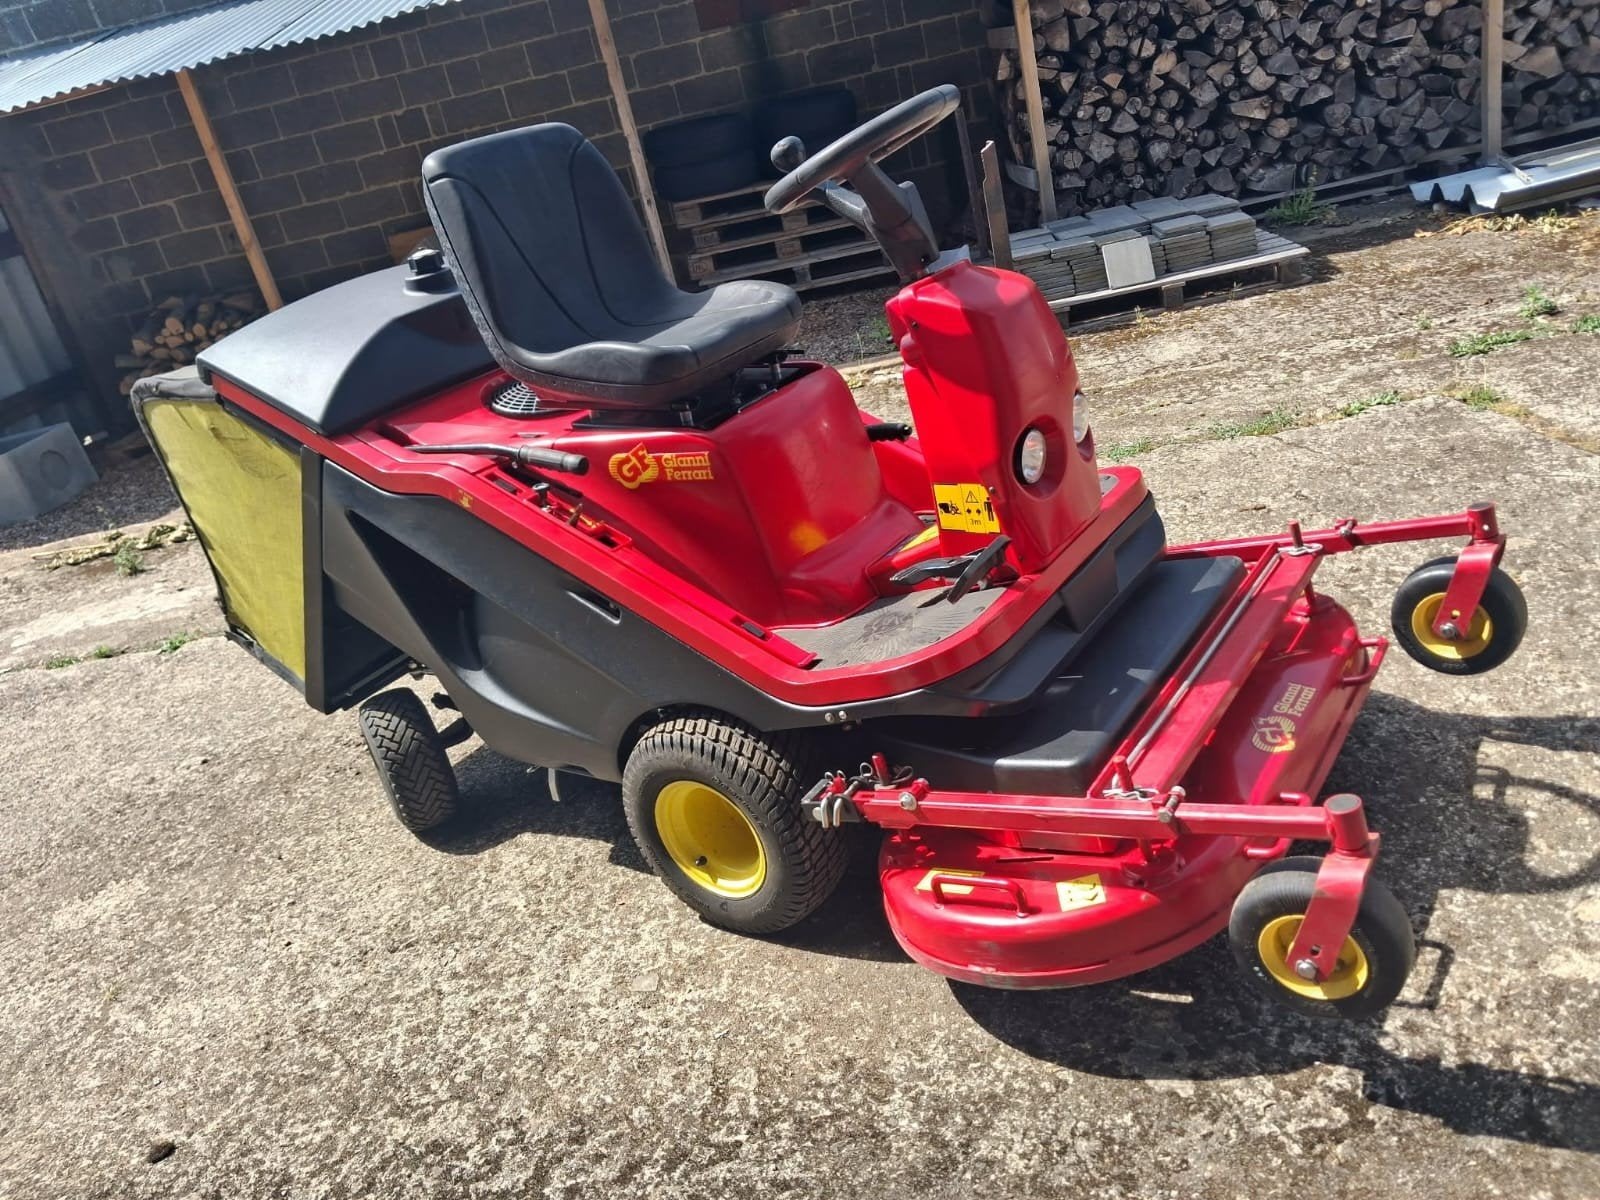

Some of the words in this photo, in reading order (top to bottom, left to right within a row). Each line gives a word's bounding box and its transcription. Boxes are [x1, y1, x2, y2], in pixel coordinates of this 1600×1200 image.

[662, 451, 711, 468] Gianni
[665, 467, 714, 480] Ferrari
[1273, 682, 1301, 713] Gianni
[1288, 686, 1317, 717] Ferrari
